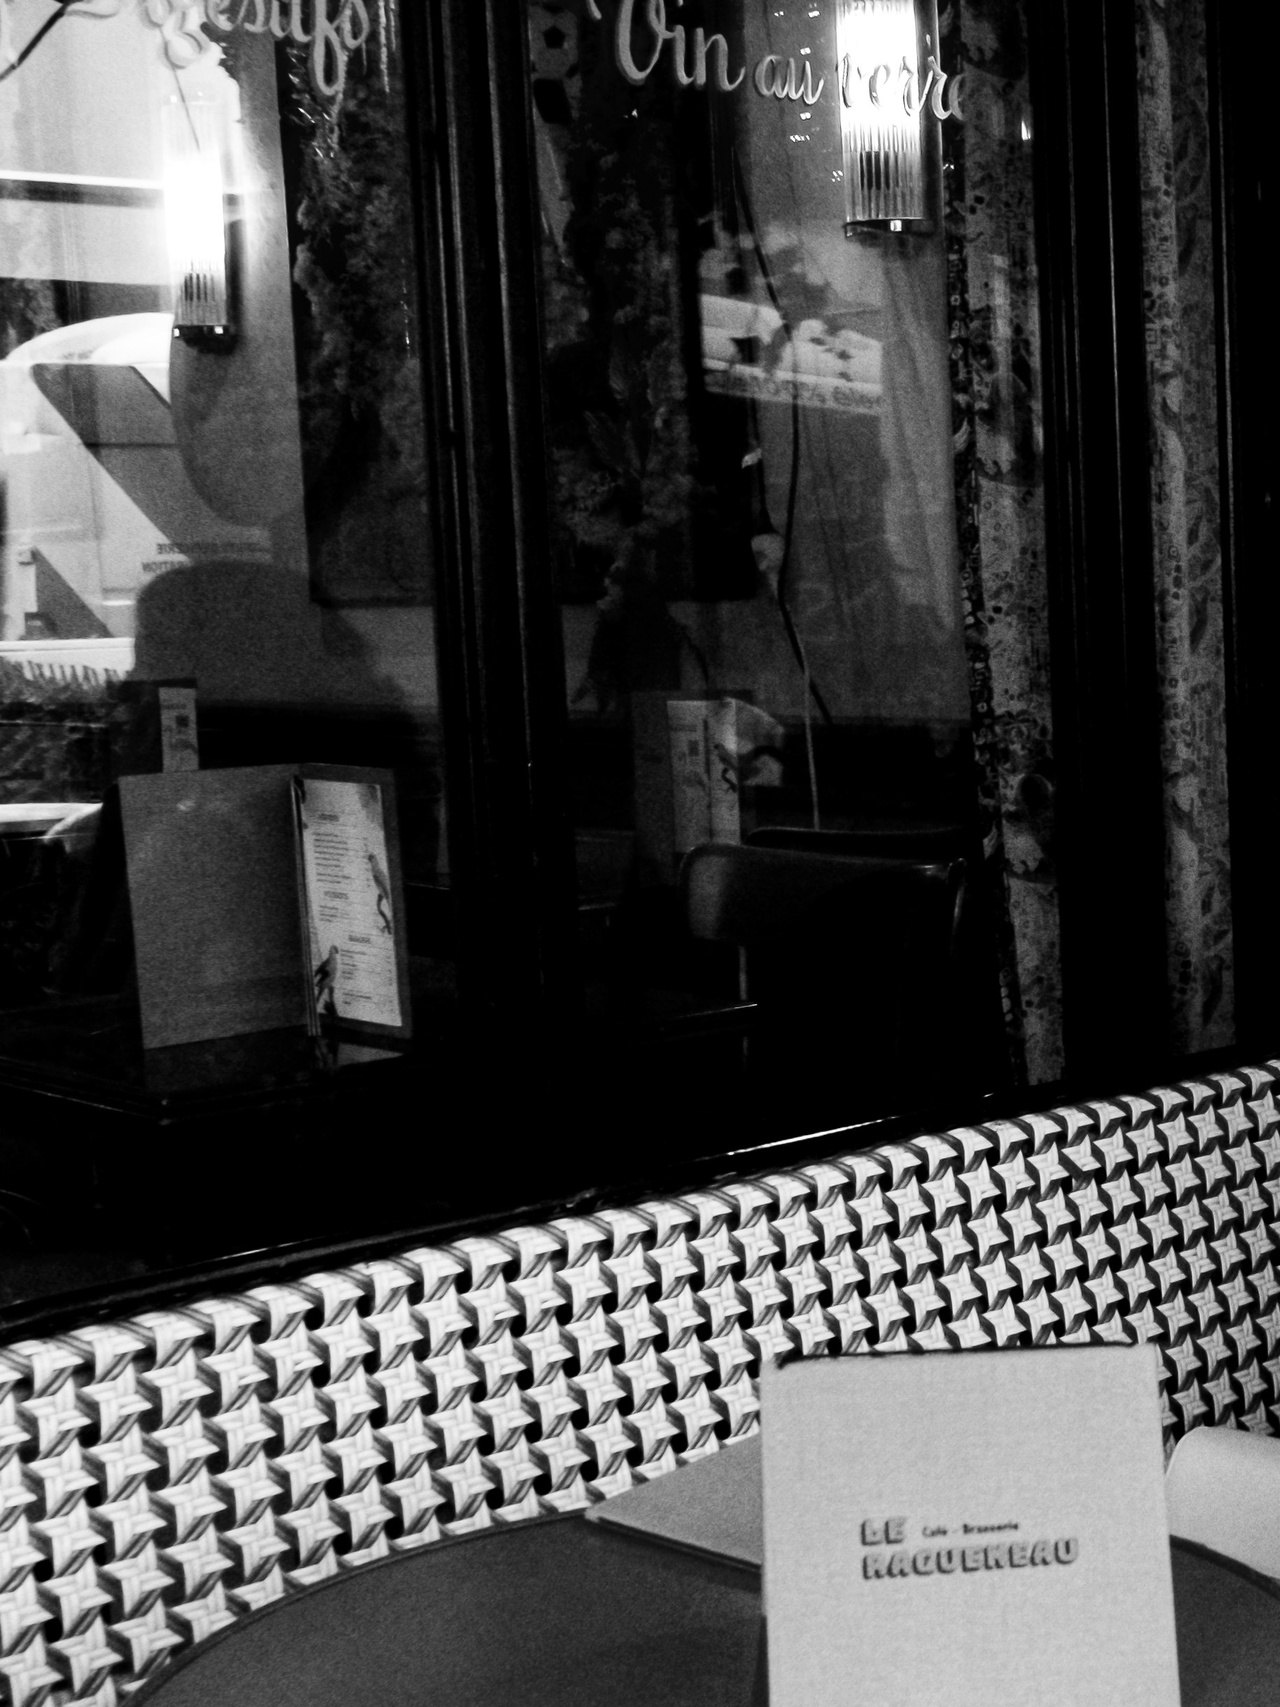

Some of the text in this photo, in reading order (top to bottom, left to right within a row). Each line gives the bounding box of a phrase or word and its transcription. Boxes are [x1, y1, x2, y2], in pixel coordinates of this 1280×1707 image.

[587, 0, 747, 92] Vin
[754, 54, 825, 106] au
[861, 1518, 905, 1545] LE
[863, 1538, 1079, 1579] RAGUENEAU
